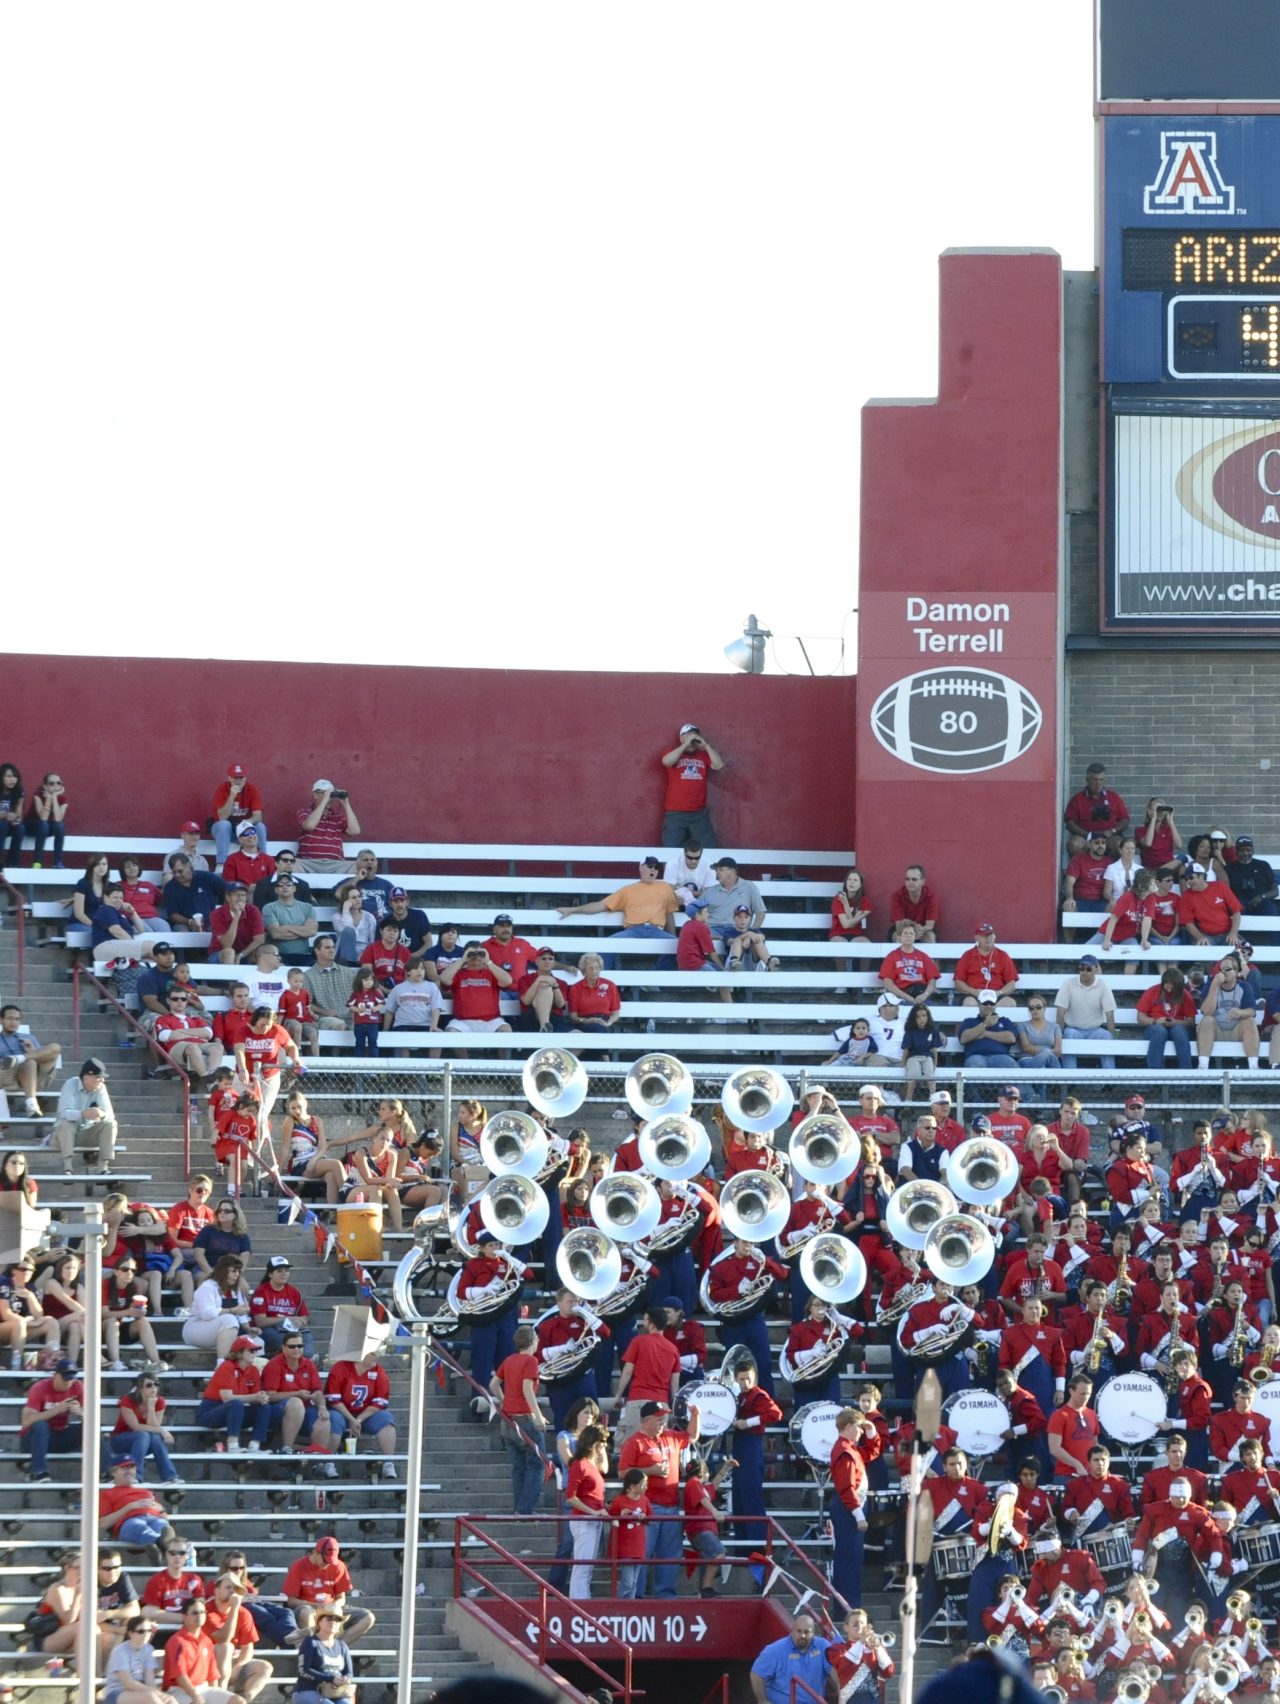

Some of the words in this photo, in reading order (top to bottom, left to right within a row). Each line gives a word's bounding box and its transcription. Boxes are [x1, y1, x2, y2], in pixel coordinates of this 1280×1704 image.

[907, 597, 1010, 622] Damon
[913, 628, 1003, 653] Terrell
[939, 711, 978, 734] 80
[883, 1028, 894, 1041] 7
[351, 1385, 368, 1408] 7
[1123, 1383, 1152, 1393] YAMAHA
[969, 1400, 998, 1409] YAMAHA
[819, 1414, 838, 1422] YAMA
[549, 1616, 562, 1643] 9
[571, 1615, 655, 1643] SECTION
[663, 1615, 685, 1643] 10
